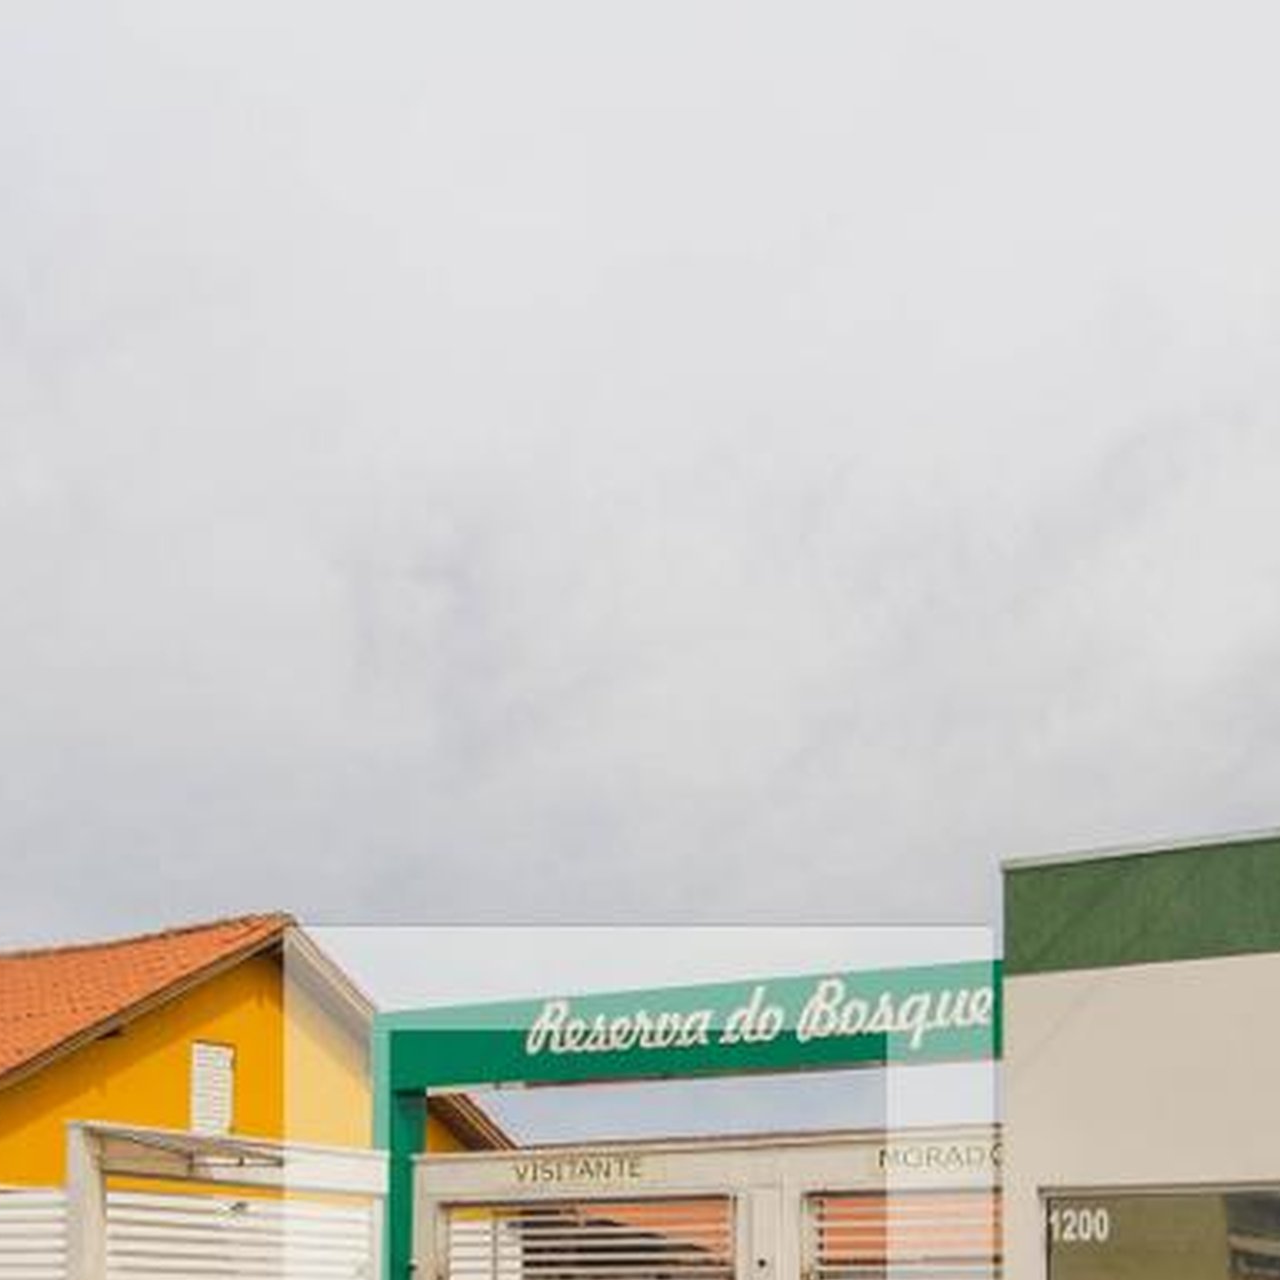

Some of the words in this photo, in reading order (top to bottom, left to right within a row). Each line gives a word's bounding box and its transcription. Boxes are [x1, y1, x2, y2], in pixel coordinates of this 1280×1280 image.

[525, 998, 711, 1054] Reserva
[719, 986, 785, 1044] do
[797, 977, 995, 1050] Bosque
[515, 1158, 641, 1182] VISITANTE
[1049, 1207, 1110, 1243] 1200
